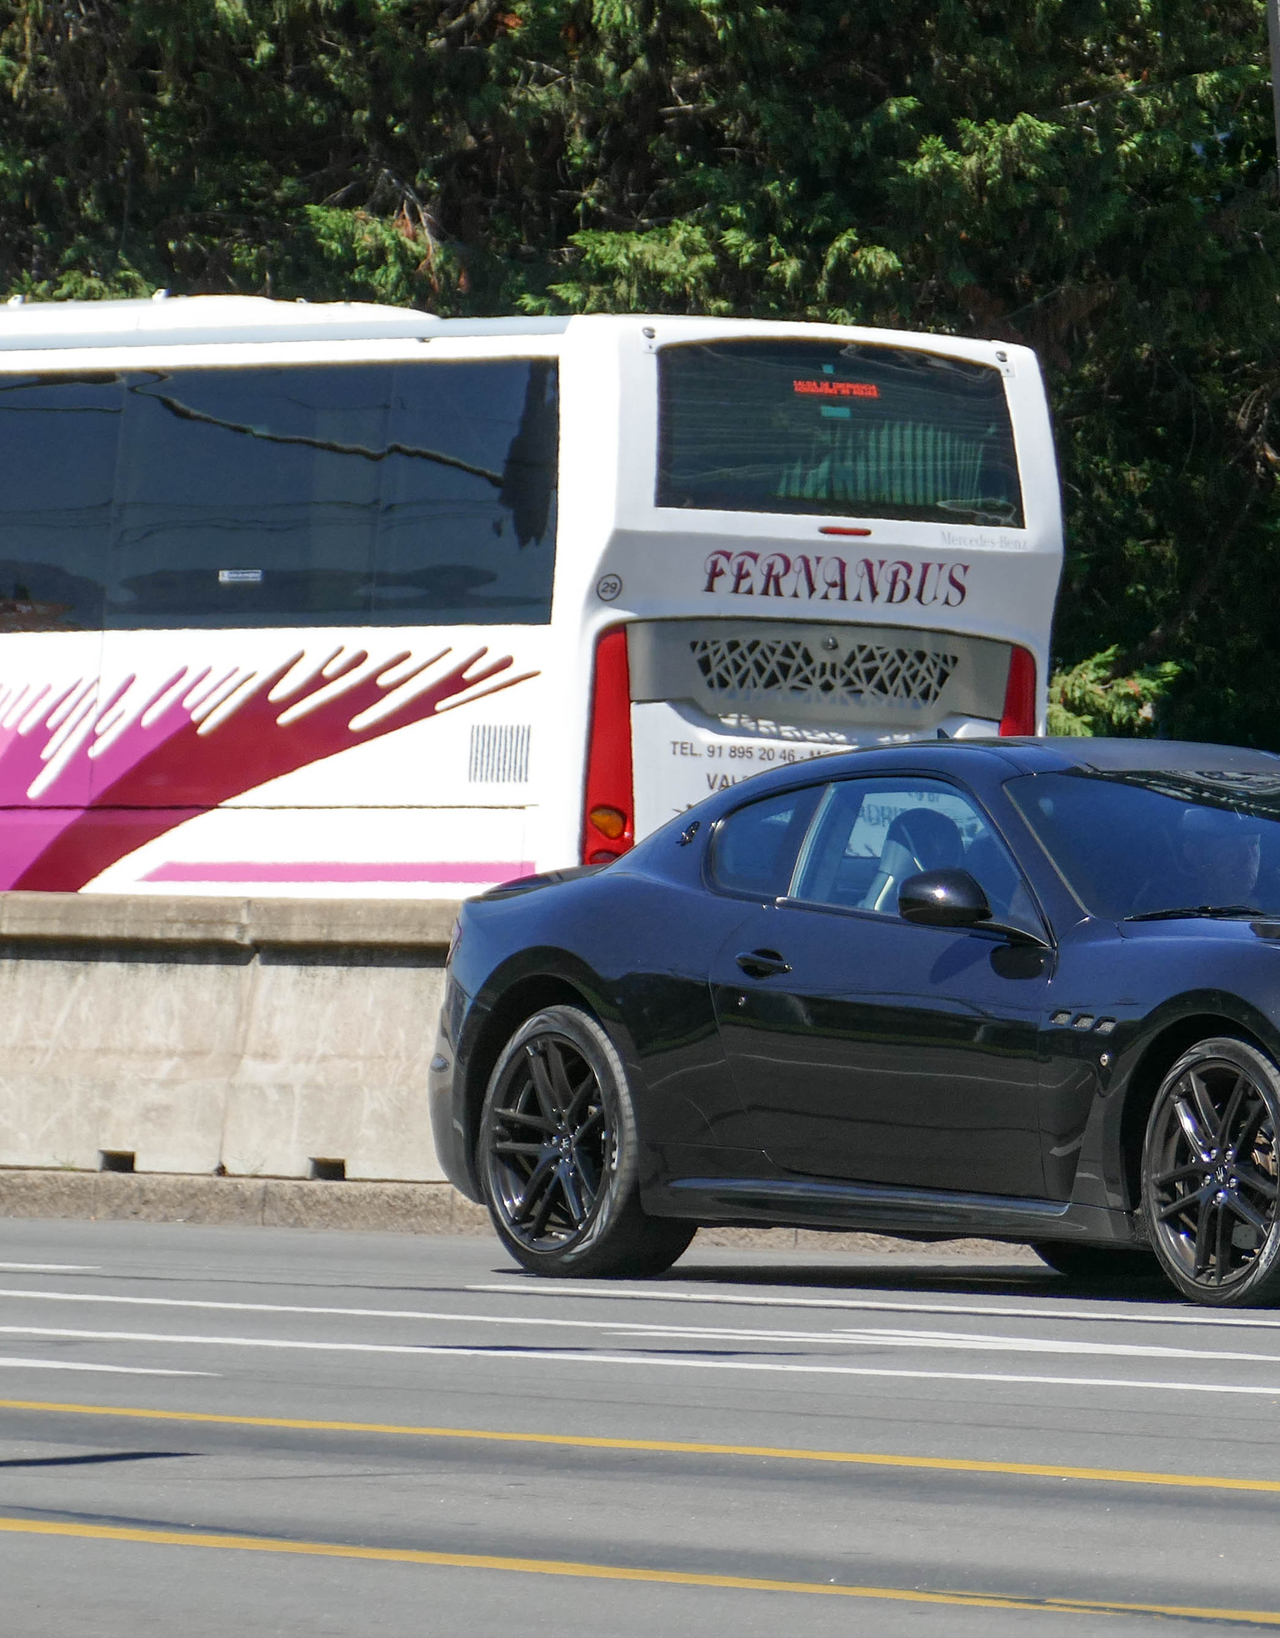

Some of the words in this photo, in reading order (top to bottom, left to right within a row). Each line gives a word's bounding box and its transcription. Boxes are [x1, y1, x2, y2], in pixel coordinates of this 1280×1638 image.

[601, 581, 618, 594] 29
[703, 549, 970, 607] FERNANBUS
[671, 741, 702, 757] TEL.
[707, 745, 723, 758] 91
[729, 746, 753, 760] 895
[758, 748, 775, 761] 20
[779, 749, 795, 763] 46
